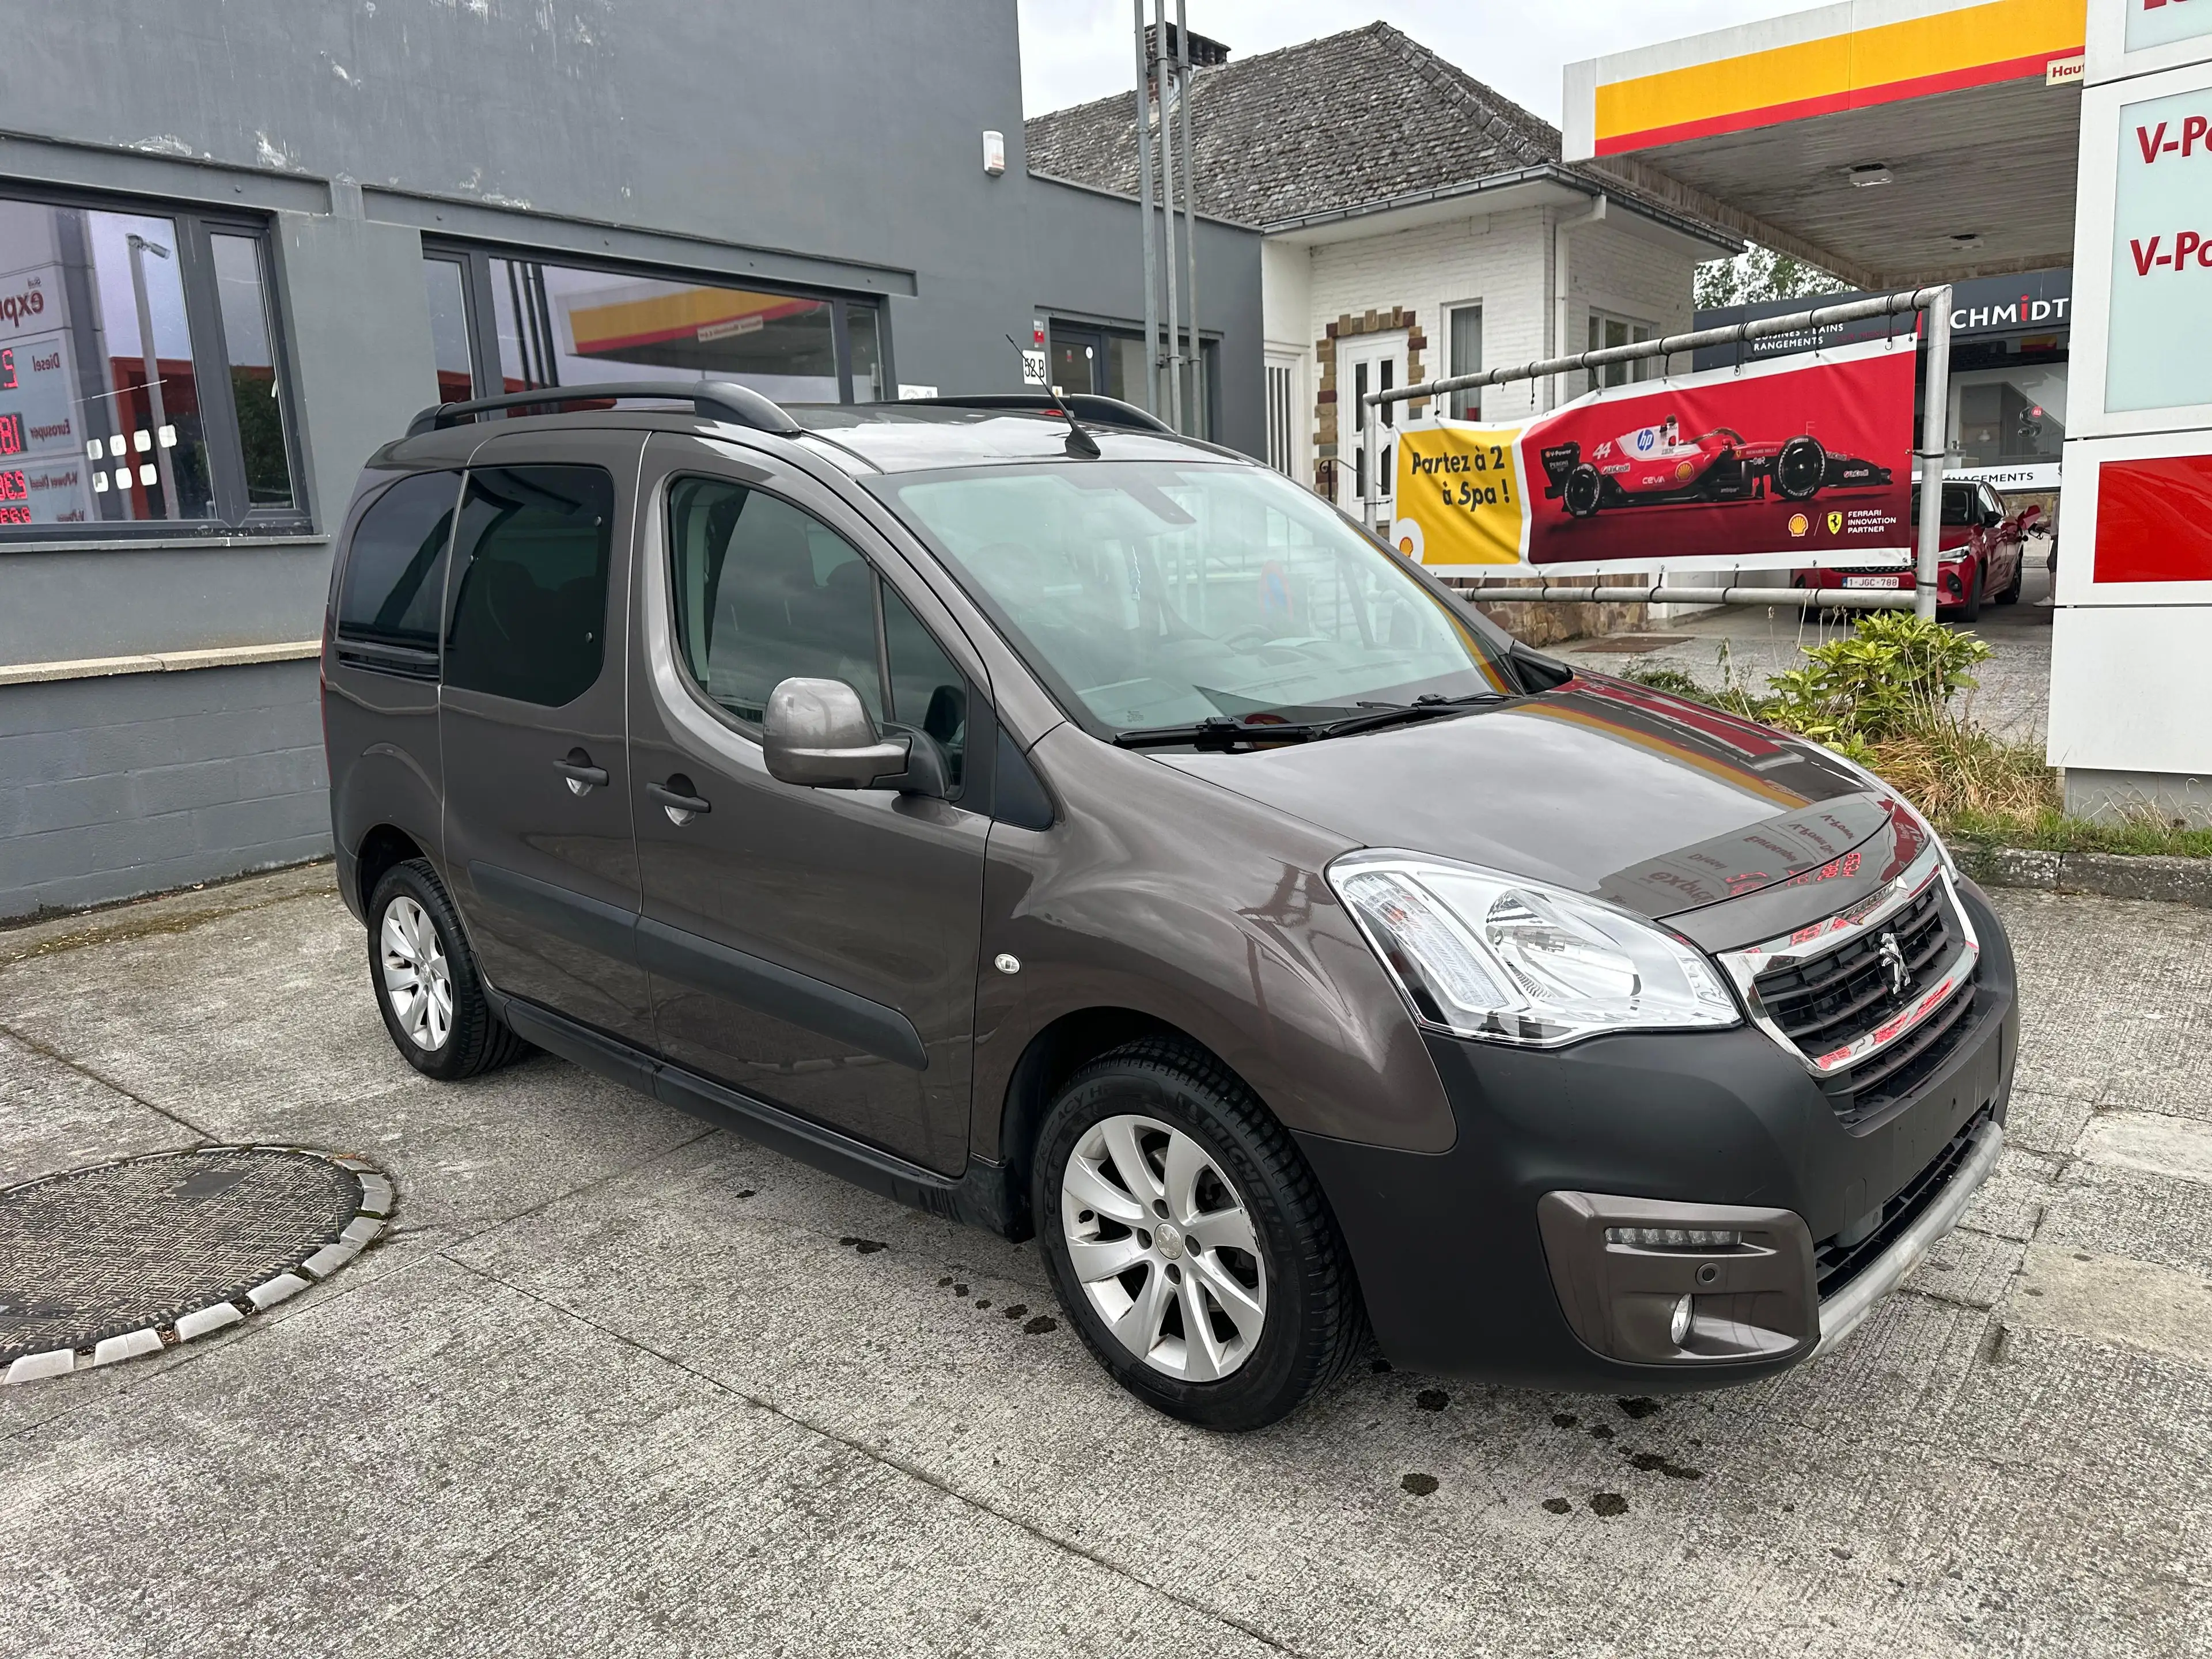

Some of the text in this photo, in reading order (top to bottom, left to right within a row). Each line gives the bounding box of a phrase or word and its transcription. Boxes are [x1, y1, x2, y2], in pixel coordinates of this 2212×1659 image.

[1753, 336, 1823, 351] RANGEMENTS
[1639, 433, 1653, 450] hp
[1593, 442, 1611, 460] 44
[1412, 445, 1505, 475] Partez à 2
[1442, 479, 1509, 512] à Spa !
[1848, 509, 1882, 518] FERRARI
[1848, 517, 1896, 525] INNOVATION
[1848, 525, 1884, 533] PARTNER
